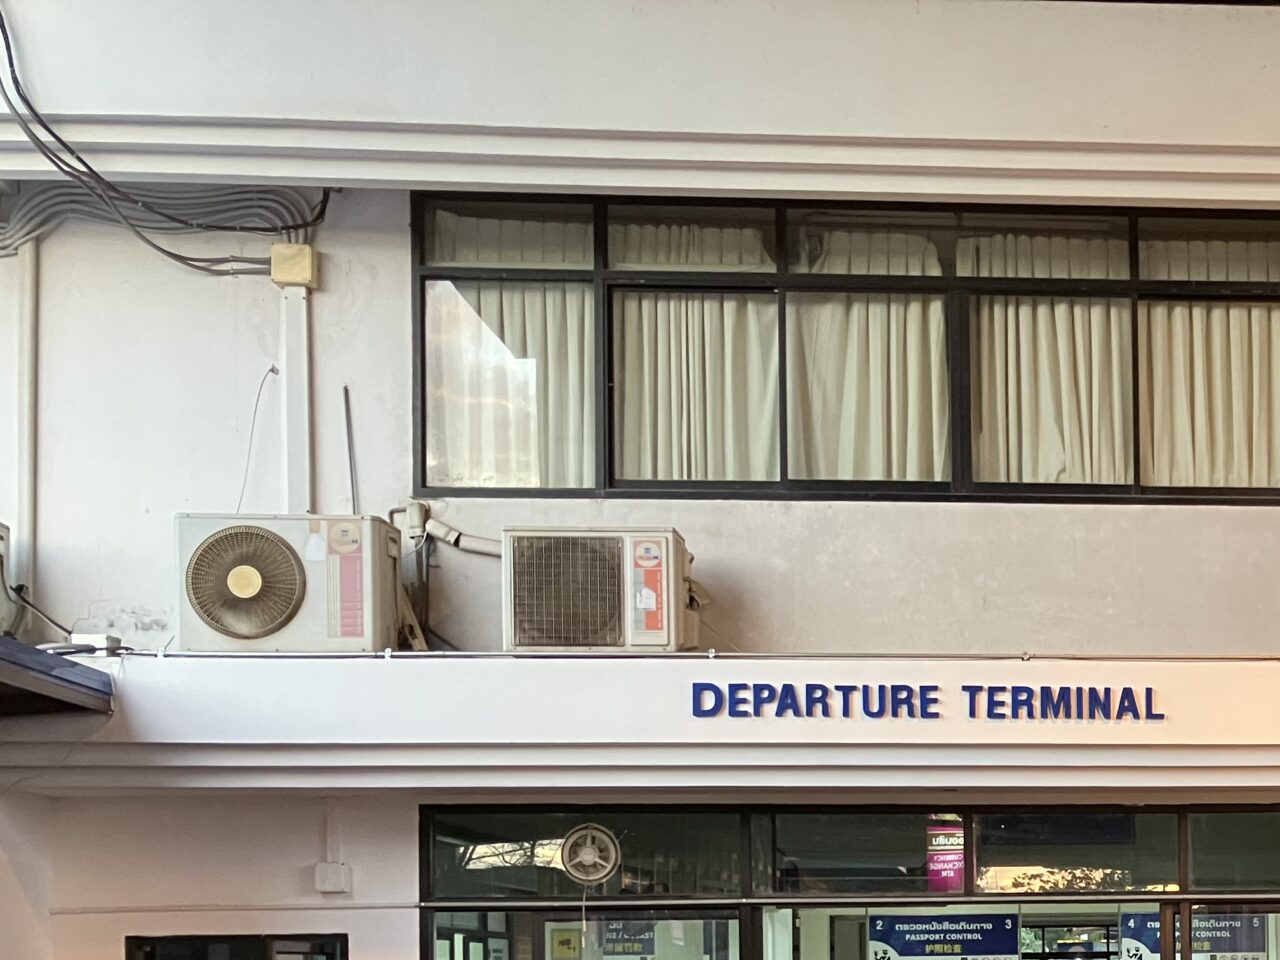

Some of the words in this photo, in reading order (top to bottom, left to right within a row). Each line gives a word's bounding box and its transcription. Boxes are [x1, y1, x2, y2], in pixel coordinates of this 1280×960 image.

[691, 682, 941, 719] DEPARTURE
[961, 685, 1166, 721] TERMINAL
[876, 920, 884, 930] 2
[1004, 919, 1012, 929] 3
[1127, 918, 1135, 929] 4
[1252, 918, 1260, 927] 5
[945, 933, 983, 941] CONTROL
[1196, 930, 1231, 938] CONTROL
